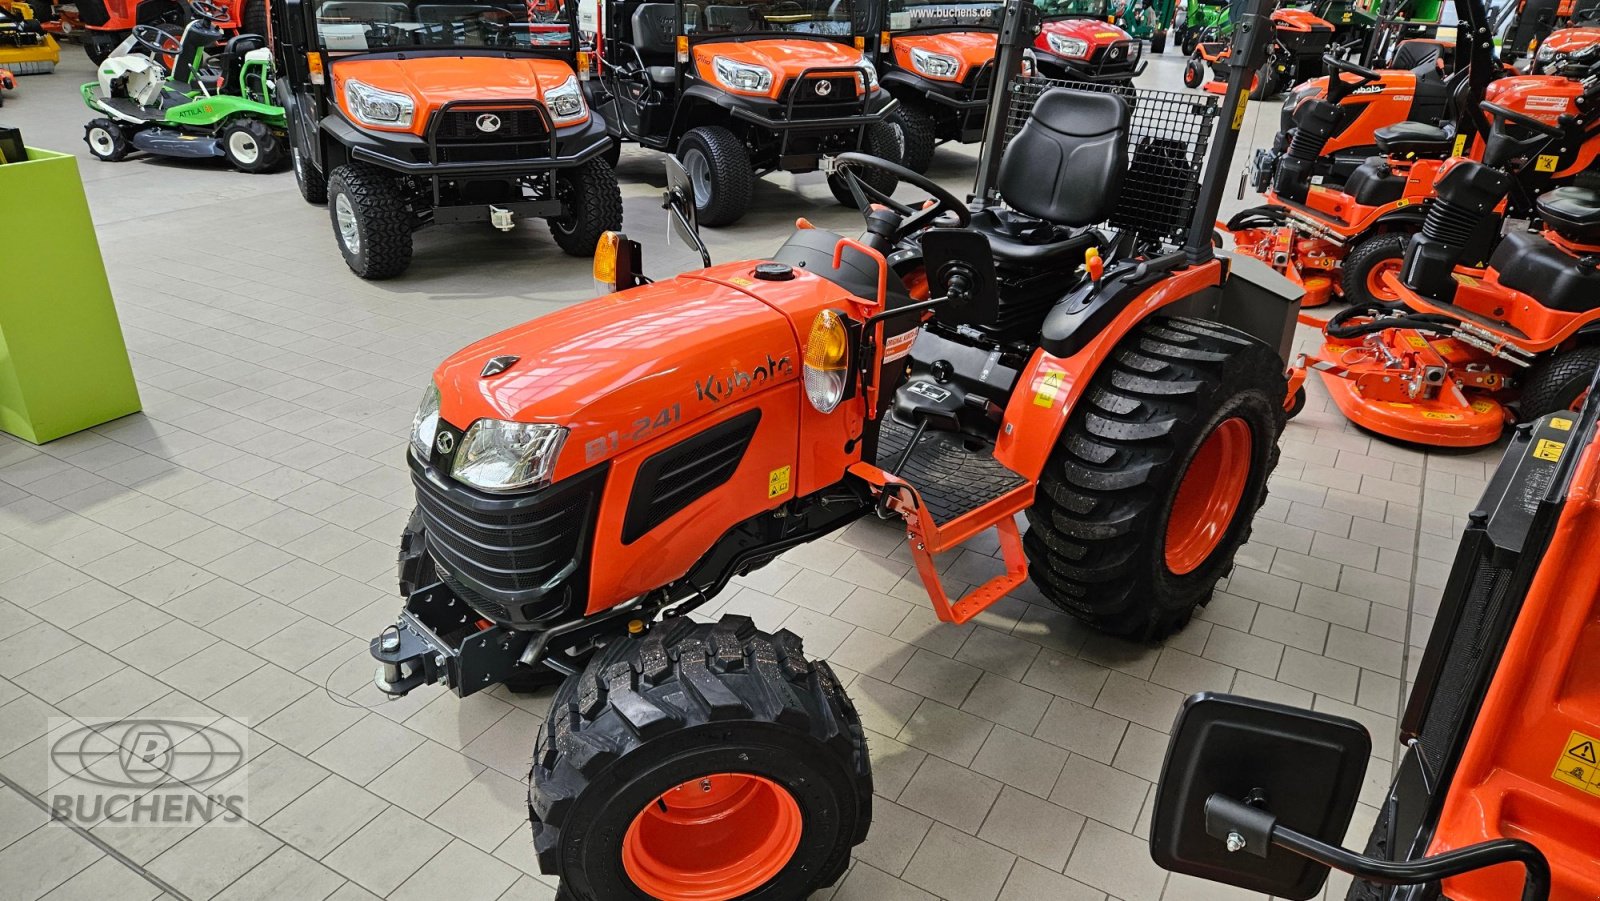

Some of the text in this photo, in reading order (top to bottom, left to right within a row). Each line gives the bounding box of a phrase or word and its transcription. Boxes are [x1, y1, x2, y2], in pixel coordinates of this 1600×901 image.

[910, 6, 992, 18] www.buchens.de
[179, 107, 203, 118] ATTILA
[695, 353, 793, 402] Kubota
[585, 402, 681, 464] B1-241
